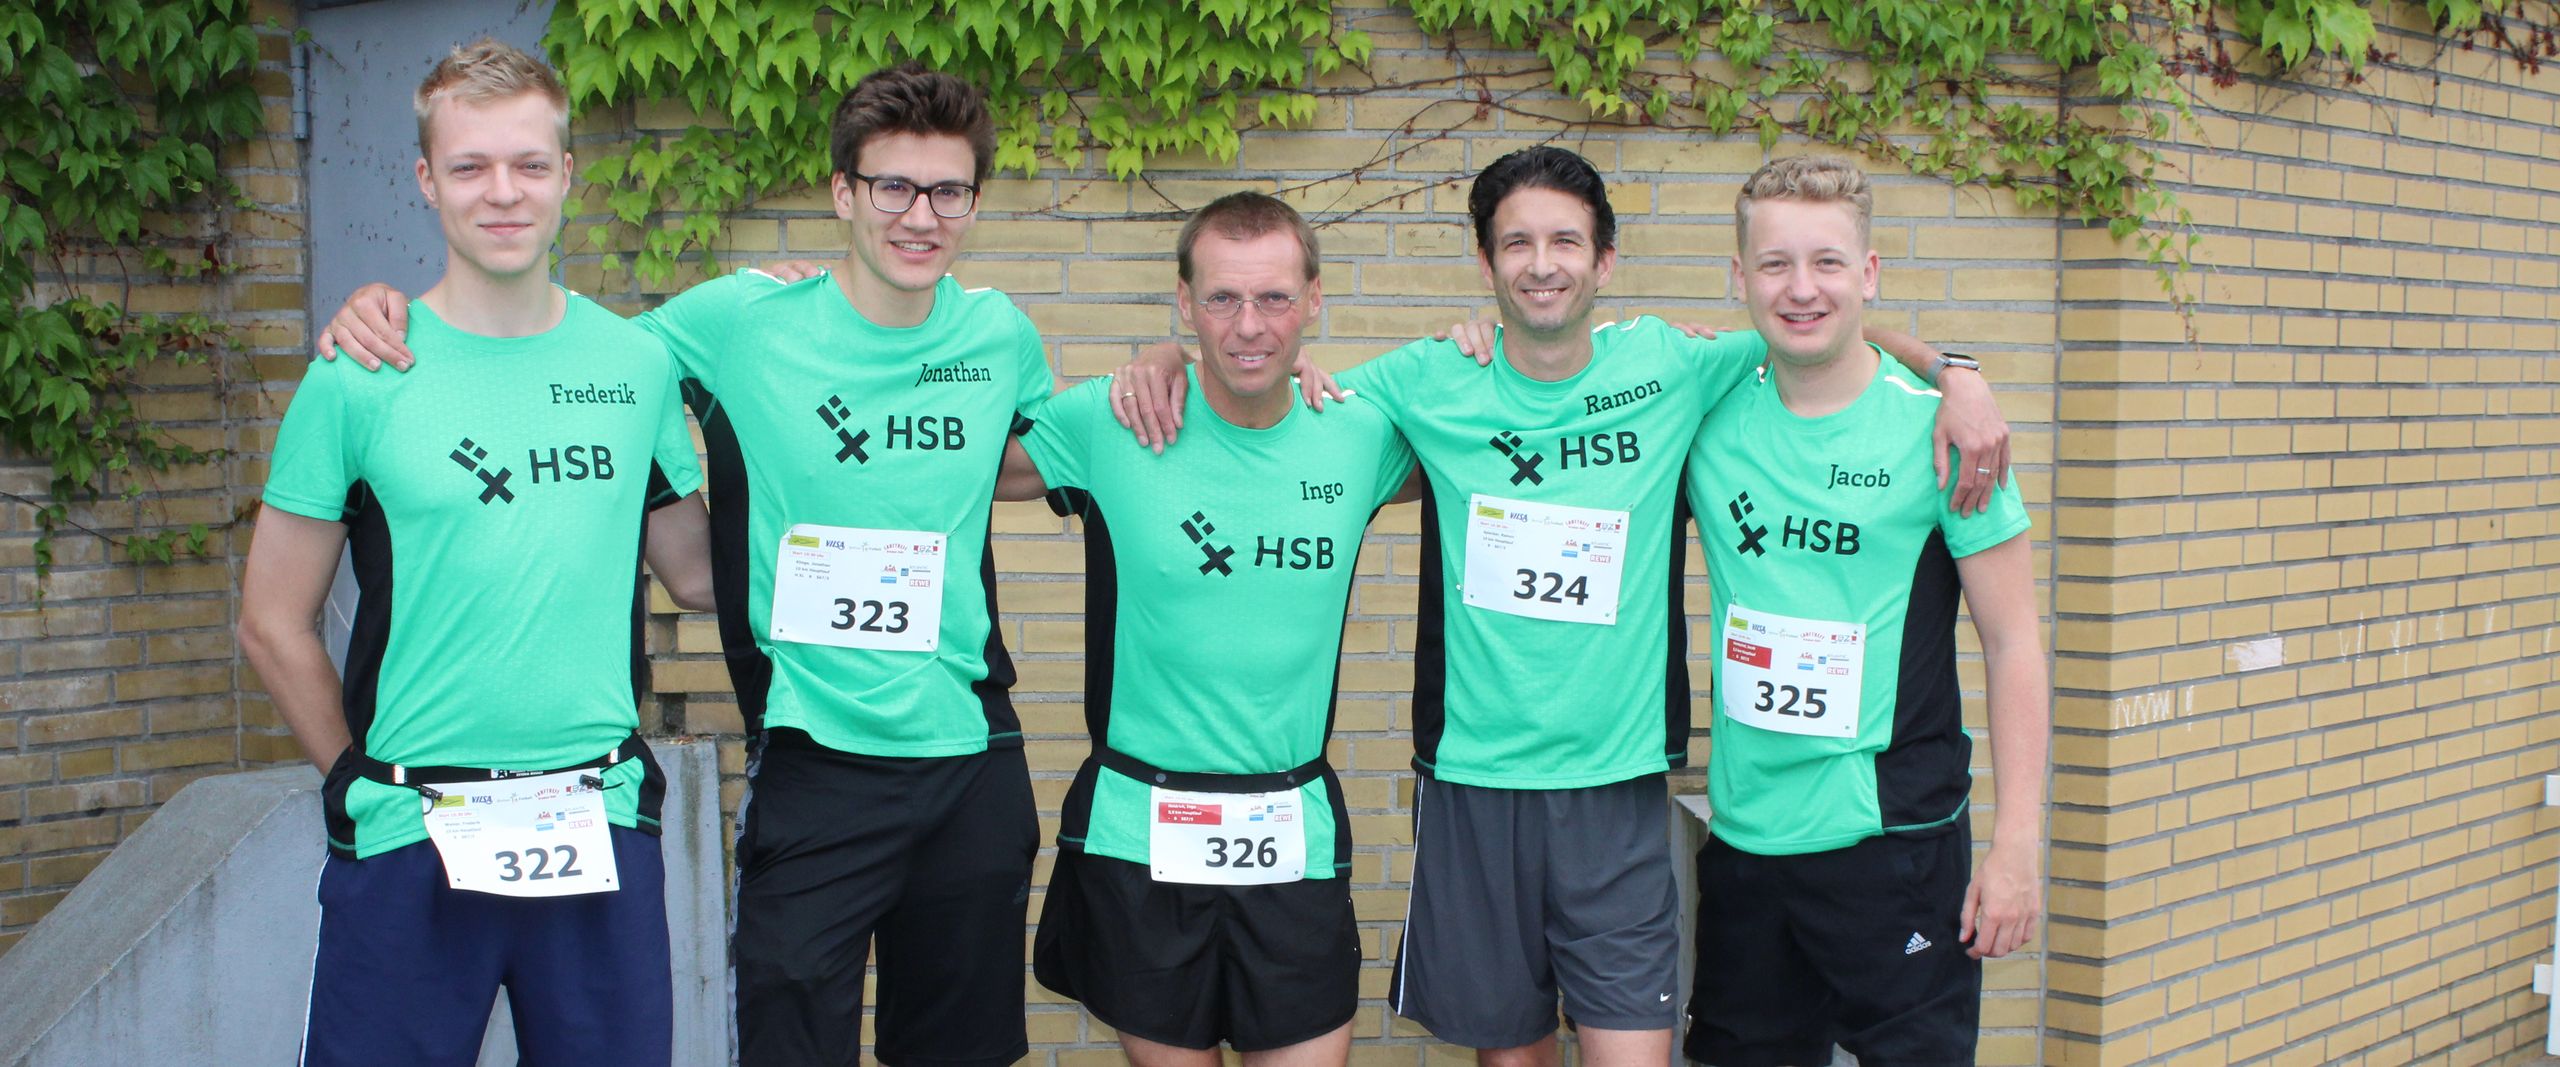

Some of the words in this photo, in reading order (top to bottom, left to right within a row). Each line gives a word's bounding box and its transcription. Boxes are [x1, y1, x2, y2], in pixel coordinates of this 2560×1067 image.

[915, 361, 991, 387] Jonathan
[550, 383, 636, 405] Frederik
[1584, 380, 1662, 415] Ramon
[887, 415, 965, 450] HSB
[1560, 431, 1640, 469] HSB
[529, 445, 614, 483] HSB
[1828, 464, 1890, 489] Jacob
[1300, 481, 1343, 504] Ingo
[1255, 536, 1334, 570] HSB
[1782, 516, 1860, 555] HSB
[909, 579, 930, 587] REWE
[1514, 569, 1588, 605] 324
[831, 598, 909, 633] 323
[1755, 681, 1826, 718] 325
[496, 845, 582, 881] 322
[1206, 837, 1277, 867] 326
[1905, 940, 1932, 955] adidas
